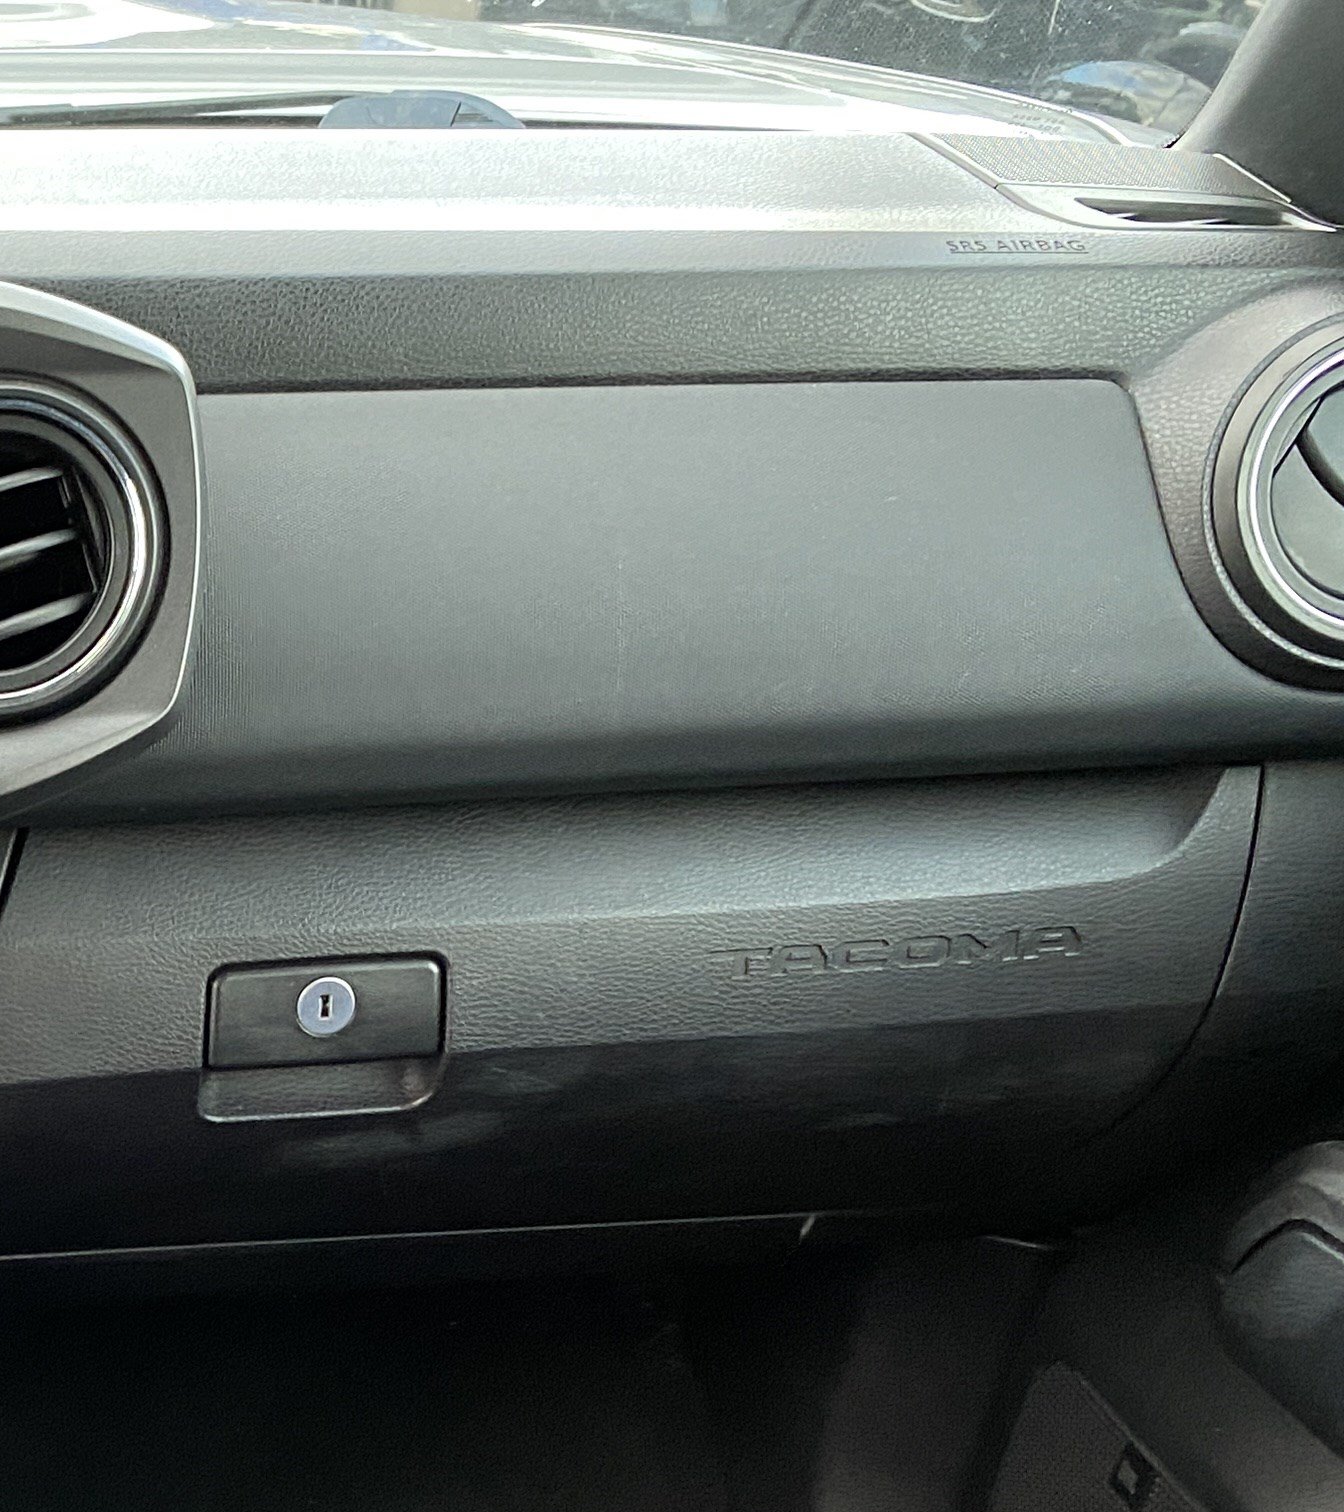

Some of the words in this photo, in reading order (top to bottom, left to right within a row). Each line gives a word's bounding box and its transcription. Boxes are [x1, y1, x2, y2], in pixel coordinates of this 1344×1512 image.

[945, 239, 988, 252] SRS
[996, 239, 1087, 252] AIRBAG
[707, 924, 1083, 981] TACOMA
